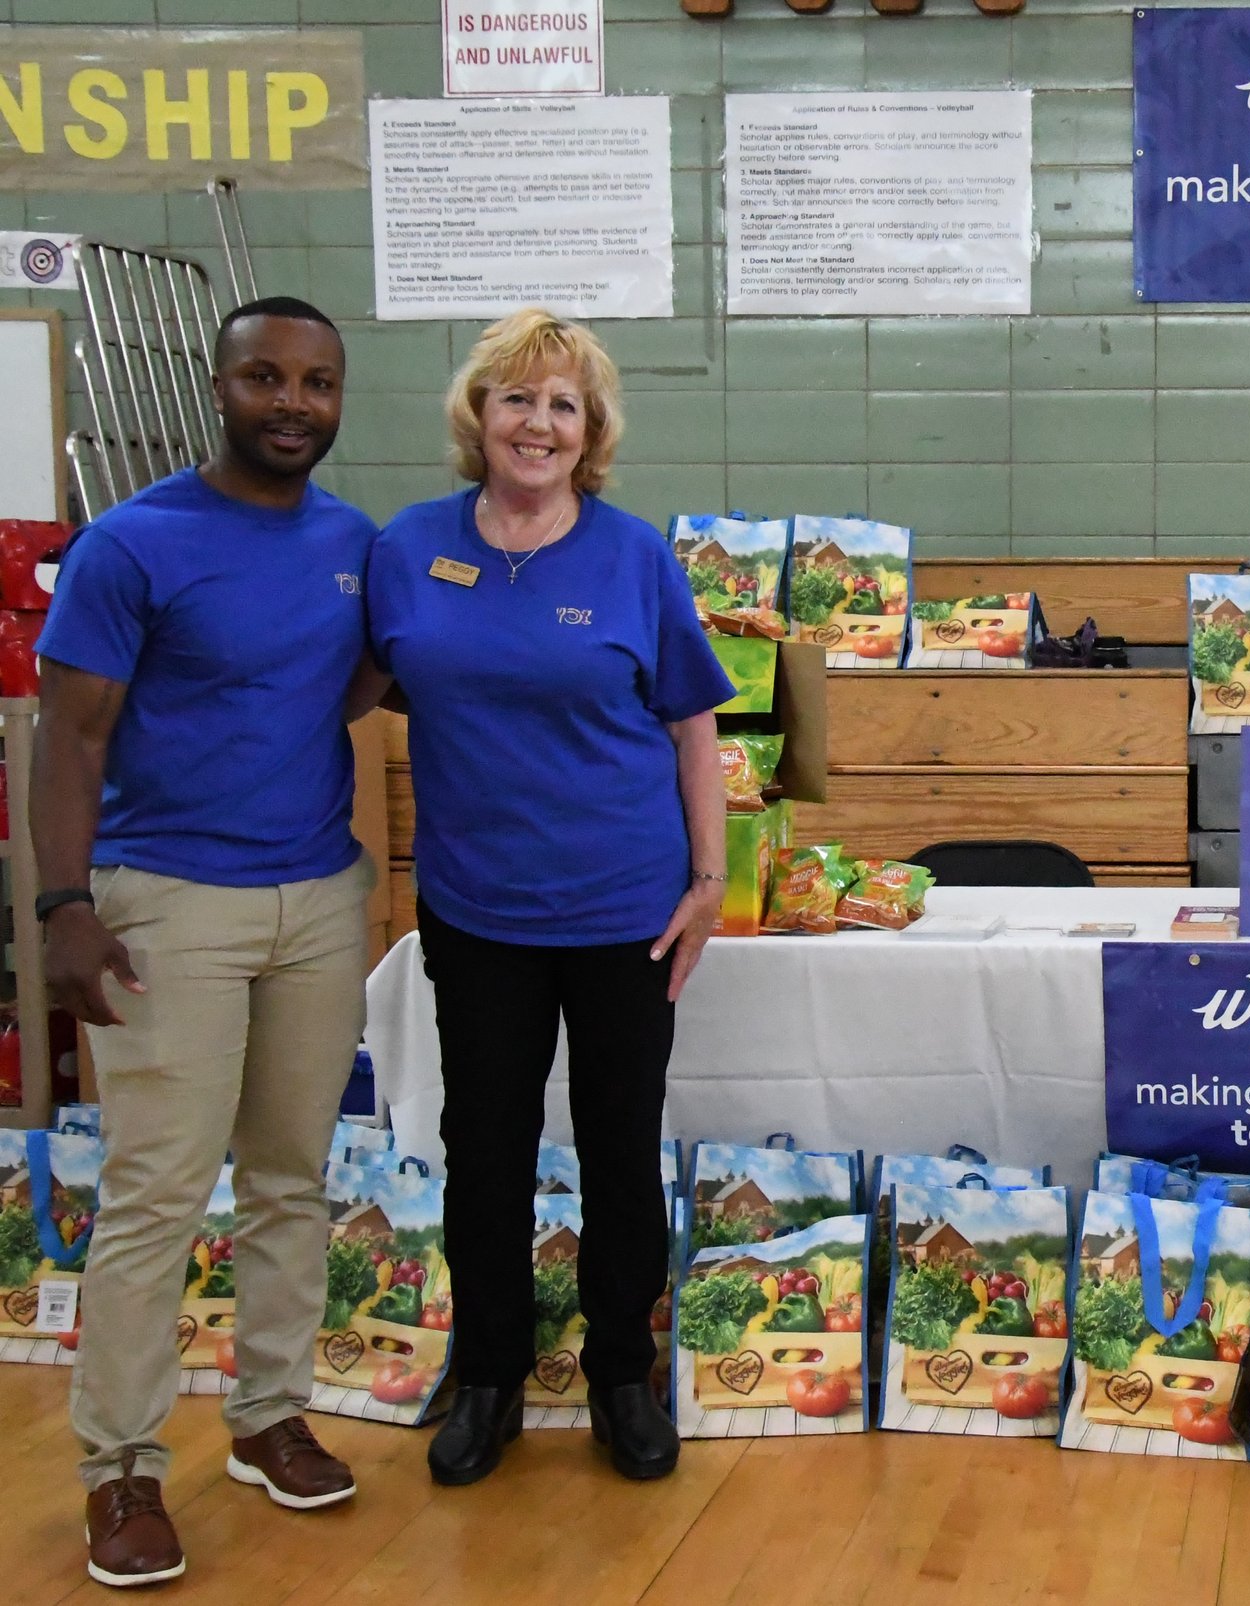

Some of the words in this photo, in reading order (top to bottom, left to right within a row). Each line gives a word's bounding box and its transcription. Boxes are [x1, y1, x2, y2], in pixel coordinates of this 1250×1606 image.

[458, 14, 474, 33] IS
[481, 14, 588, 32] DANGEROUS
[455, 46, 491, 66] AND
[496, 46, 594, 65] UNLAWFUL
[0, 62, 330, 162] NSHIP
[791, 106, 835, 114] Application
[936, 104, 974, 113] Volleyball
